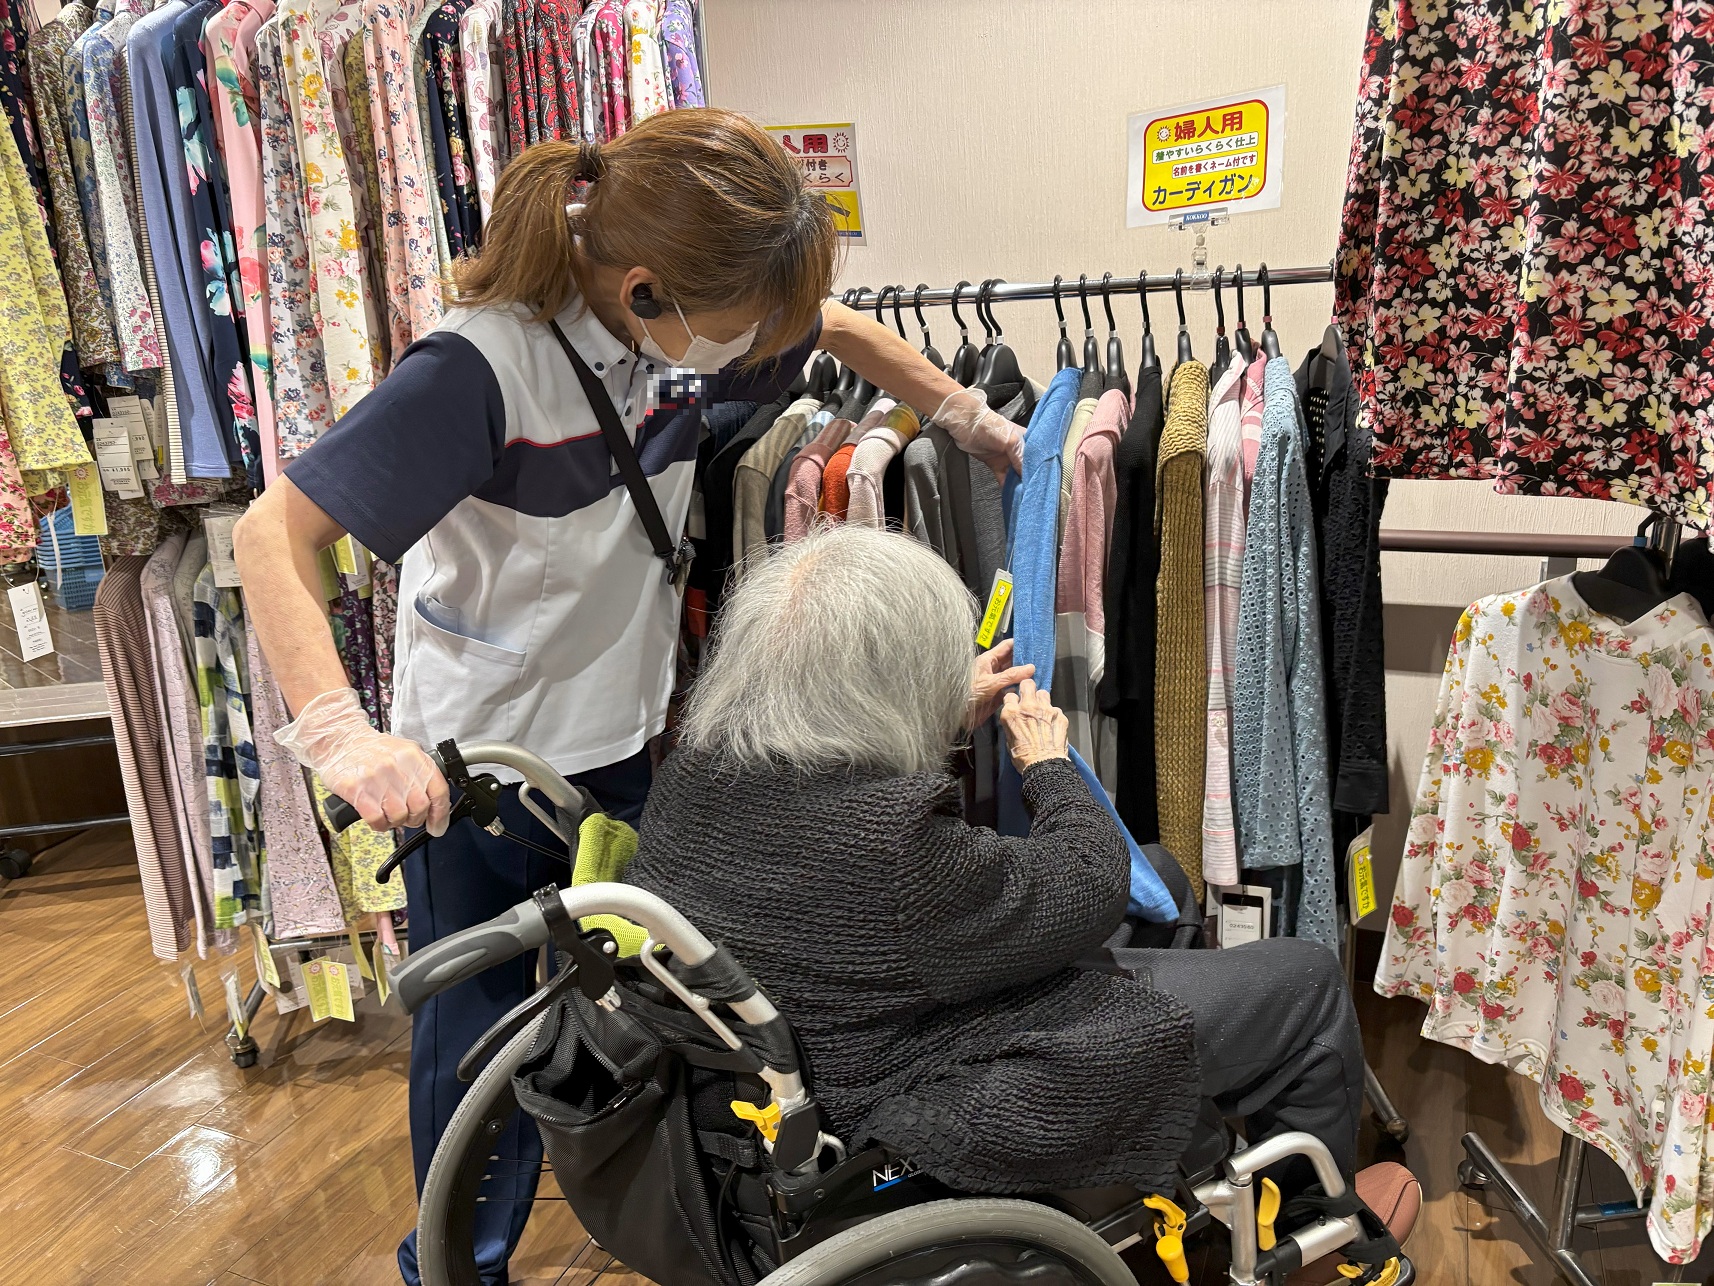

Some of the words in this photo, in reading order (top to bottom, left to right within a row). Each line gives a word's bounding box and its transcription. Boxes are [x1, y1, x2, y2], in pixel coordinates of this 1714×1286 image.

[1173, 111, 1243, 142] 婦人用
[1155, 135, 1256, 162] 着やすいらくらく仕上
[800, 158, 828, 172] 付き
[1173, 153, 1256, 177] 名前を書くネーム付です
[1152, 173, 1254, 206] カーディガン
[872, 1157, 914, 1187] NEX
